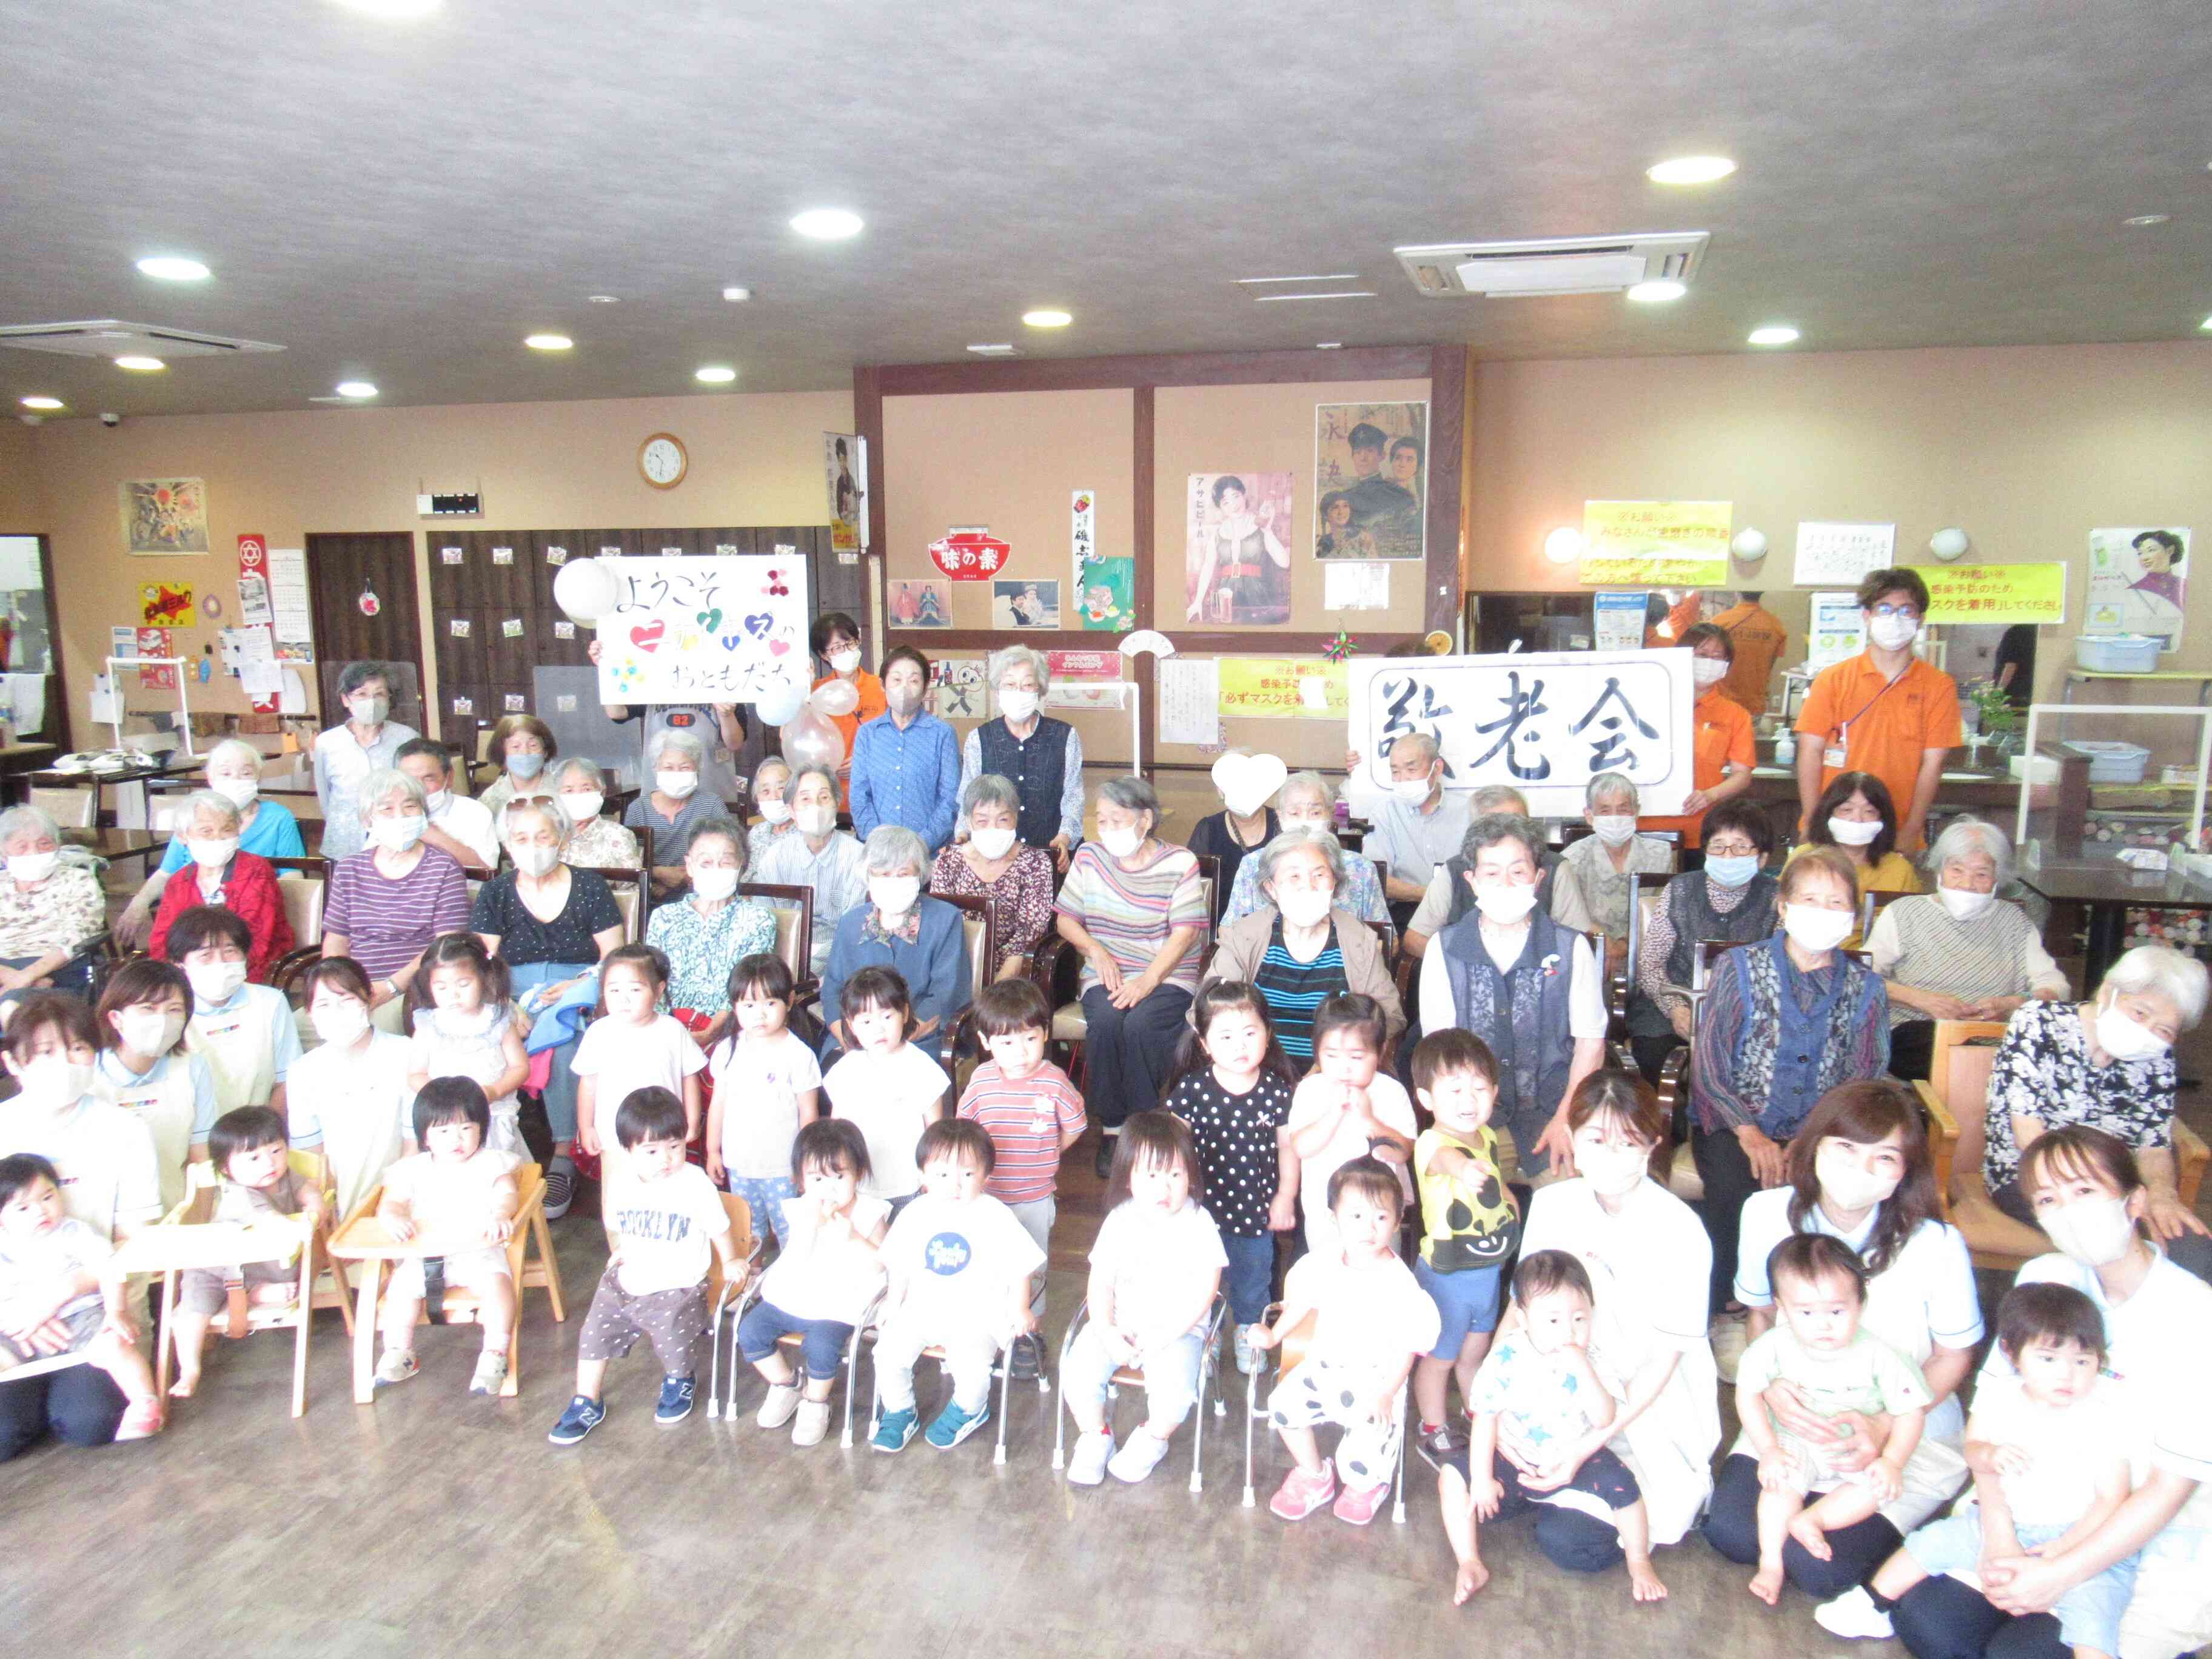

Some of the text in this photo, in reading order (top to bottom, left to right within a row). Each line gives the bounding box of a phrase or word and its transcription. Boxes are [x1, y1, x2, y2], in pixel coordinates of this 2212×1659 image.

[1196, 477, 1205, 538] アサヒビール
[941, 547, 998, 570] 味の素
[616, 572, 722, 613] ようこそ
[672, 663, 791, 692] おともだち
[1378, 671, 1660, 780] 敬老会
[616, 1210, 691, 1242] ROOKLYN
